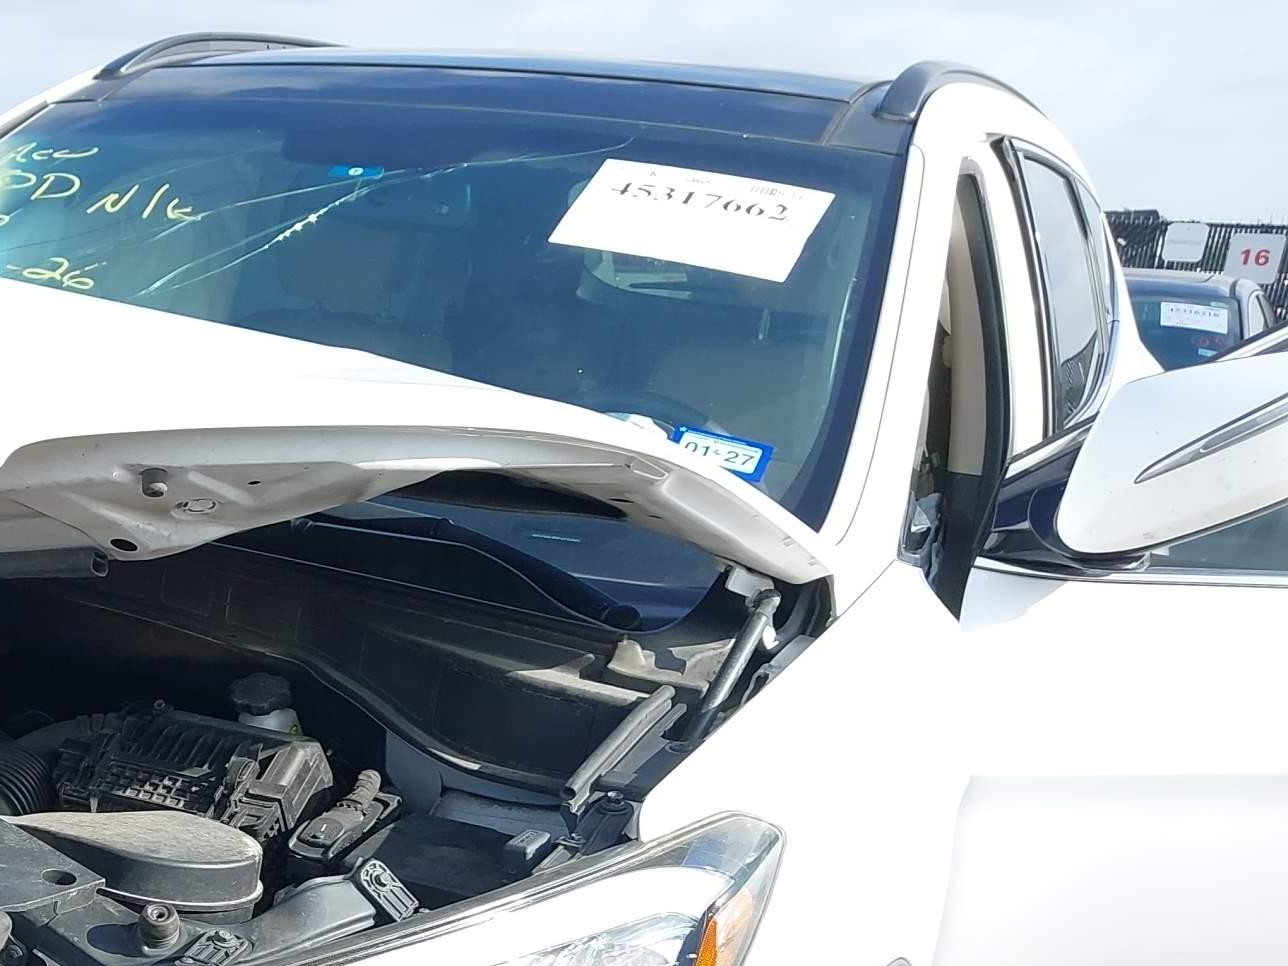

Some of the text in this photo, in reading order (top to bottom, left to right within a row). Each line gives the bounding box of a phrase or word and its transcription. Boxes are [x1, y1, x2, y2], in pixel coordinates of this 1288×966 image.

[611, 182, 788, 221] 45317662
[1240, 248, 1271, 266] 16
[723, 450, 755, 466] 27
